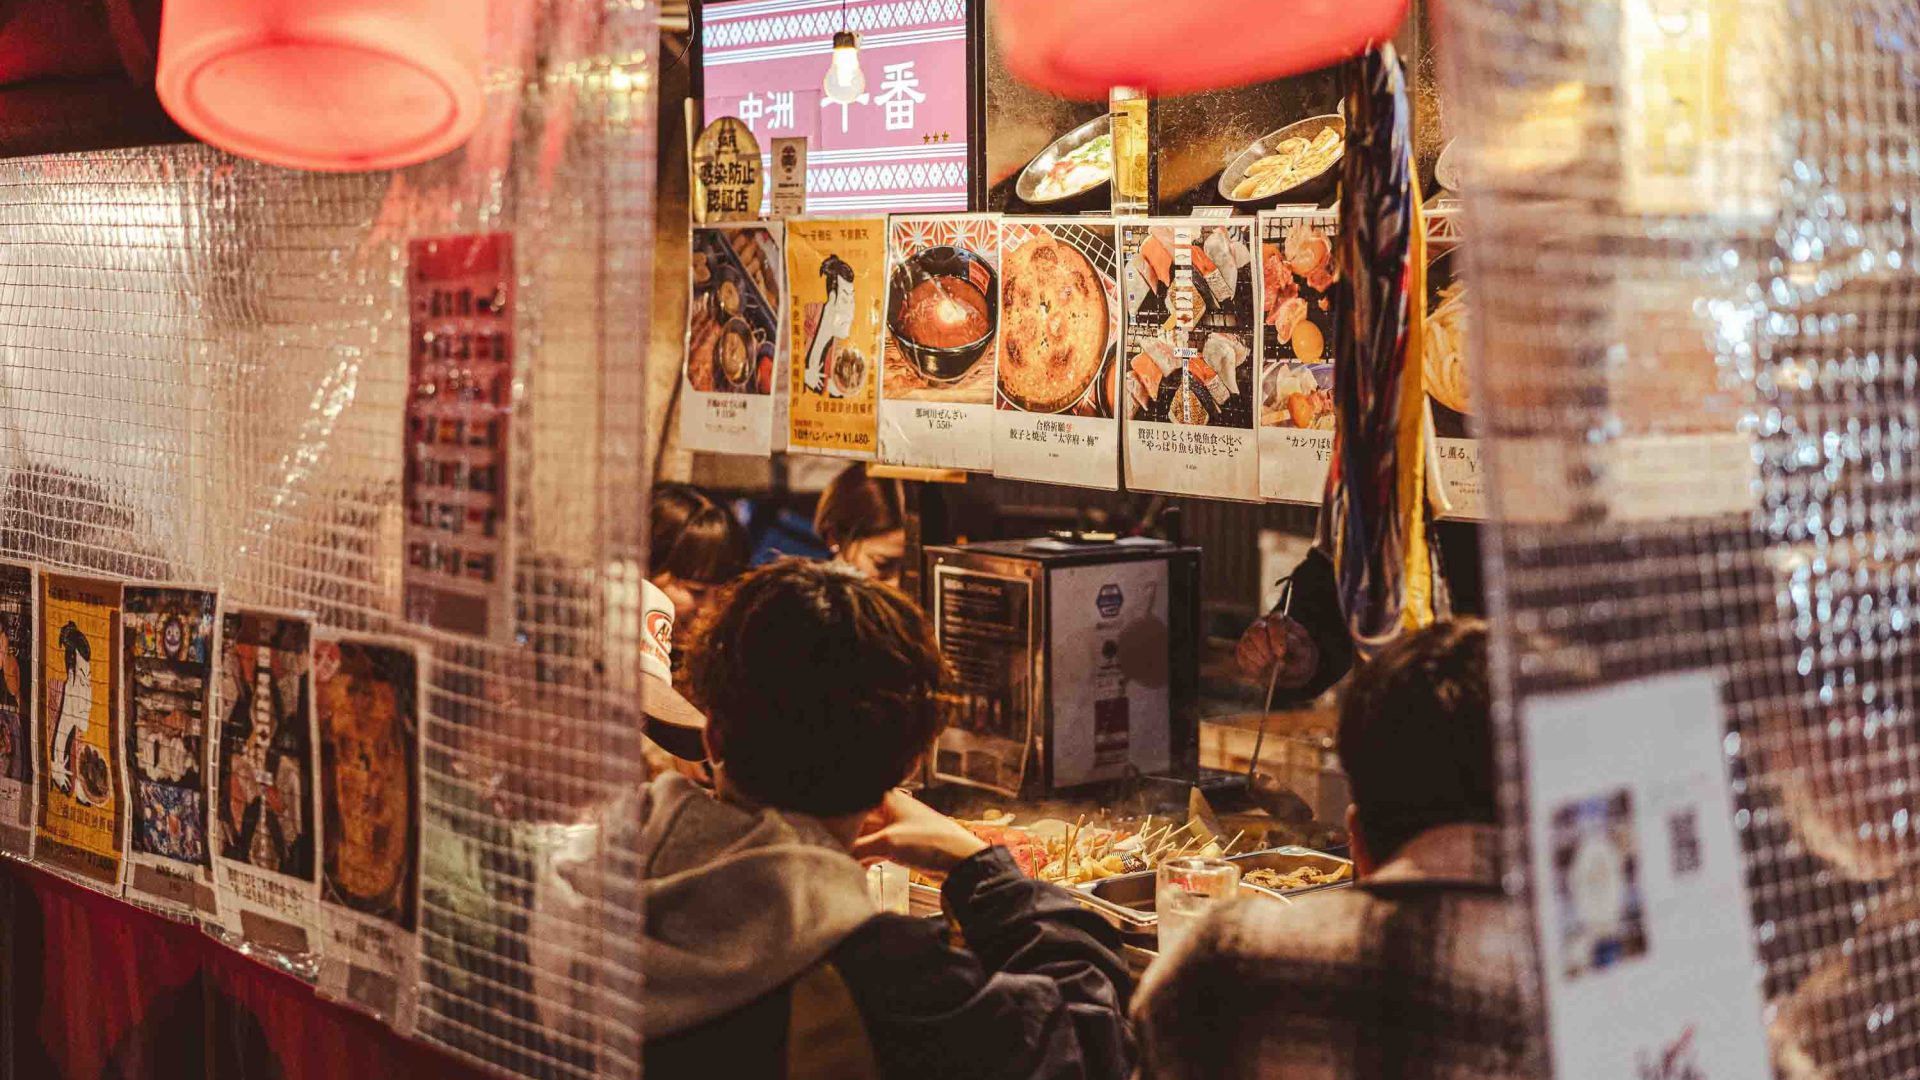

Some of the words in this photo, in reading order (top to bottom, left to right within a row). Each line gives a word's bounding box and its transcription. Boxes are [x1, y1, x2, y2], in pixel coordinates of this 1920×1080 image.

[738, 90, 794, 131] 中洲
[700, 160, 756, 187] 感染防止
[707, 188, 749, 213] 認証店
